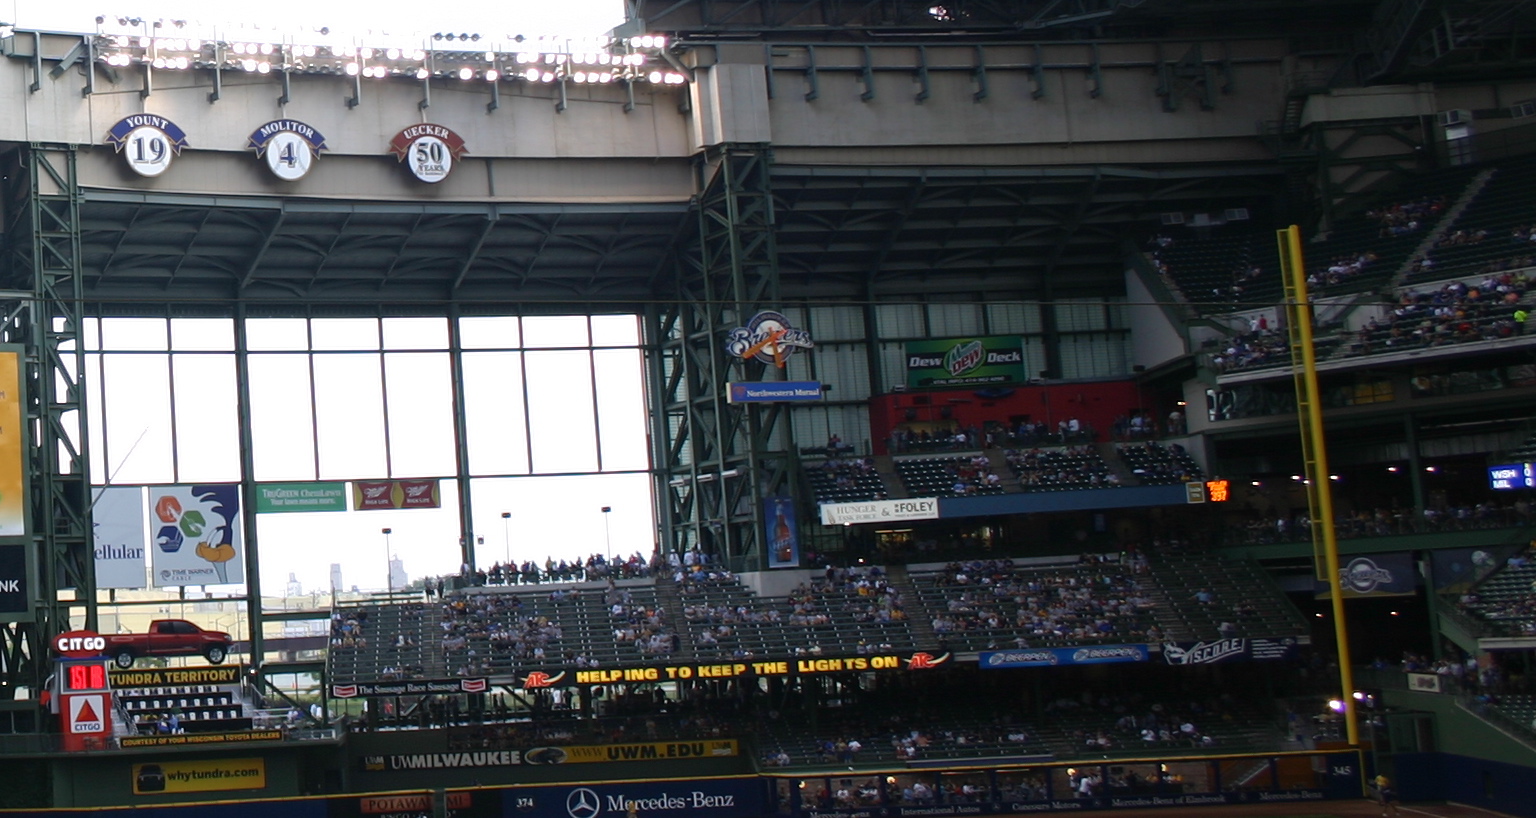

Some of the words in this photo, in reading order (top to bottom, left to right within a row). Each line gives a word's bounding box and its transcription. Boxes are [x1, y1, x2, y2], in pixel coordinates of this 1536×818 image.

[126, 116, 168, 129] YOUNT
[260, 123, 314, 138] MOLITOR
[404, 125, 449, 139] UECKER
[133, 136, 165, 164] 19
[416, 142, 445, 164] 50
[279, 146, 297, 168] 4
[909, 356, 943, 367] Dew
[987, 352, 1021, 363] Deck
[1491, 469, 1515, 479] WSH
[1493, 479, 1511, 488] MIL
[837, 504, 877, 514] HUNGER
[900, 502, 934, 512] FOLEY
[58, 637, 106, 650] CITGO
[576, 668, 657, 683] HELPING
[666, 666, 692, 679] TO
[698, 663, 746, 677] KEEP
[753, 661, 787, 674] THE
[798, 658, 867, 672] LIGHTS
[871, 656, 899, 669] ON
[109, 672, 162, 686] TUNDRA
[165, 669, 236, 683] TERRITORY
[359, 685, 372, 694] The
[375, 684, 406, 695] Sausage
[408, 683, 426, 692] Race
[428, 682, 459, 692] Sausage
[74, 723, 101, 731] CITGO
[123, 738, 156, 746] COURTESY
[158, 737, 167, 745] OF
[169, 736, 186, 744] YOUR
[187, 735, 224, 743] WISCONSIN
[251, 732, 280, 740] DEALERS
[168, 767, 259, 782] whytundra.com
[1332, 765, 1352, 776] 345
[516, 798, 534, 808] 374
[606, 791, 734, 812] Mercedes-Benz
[901, 807, 955, 815] International
[957, 805, 980, 813] Autos
